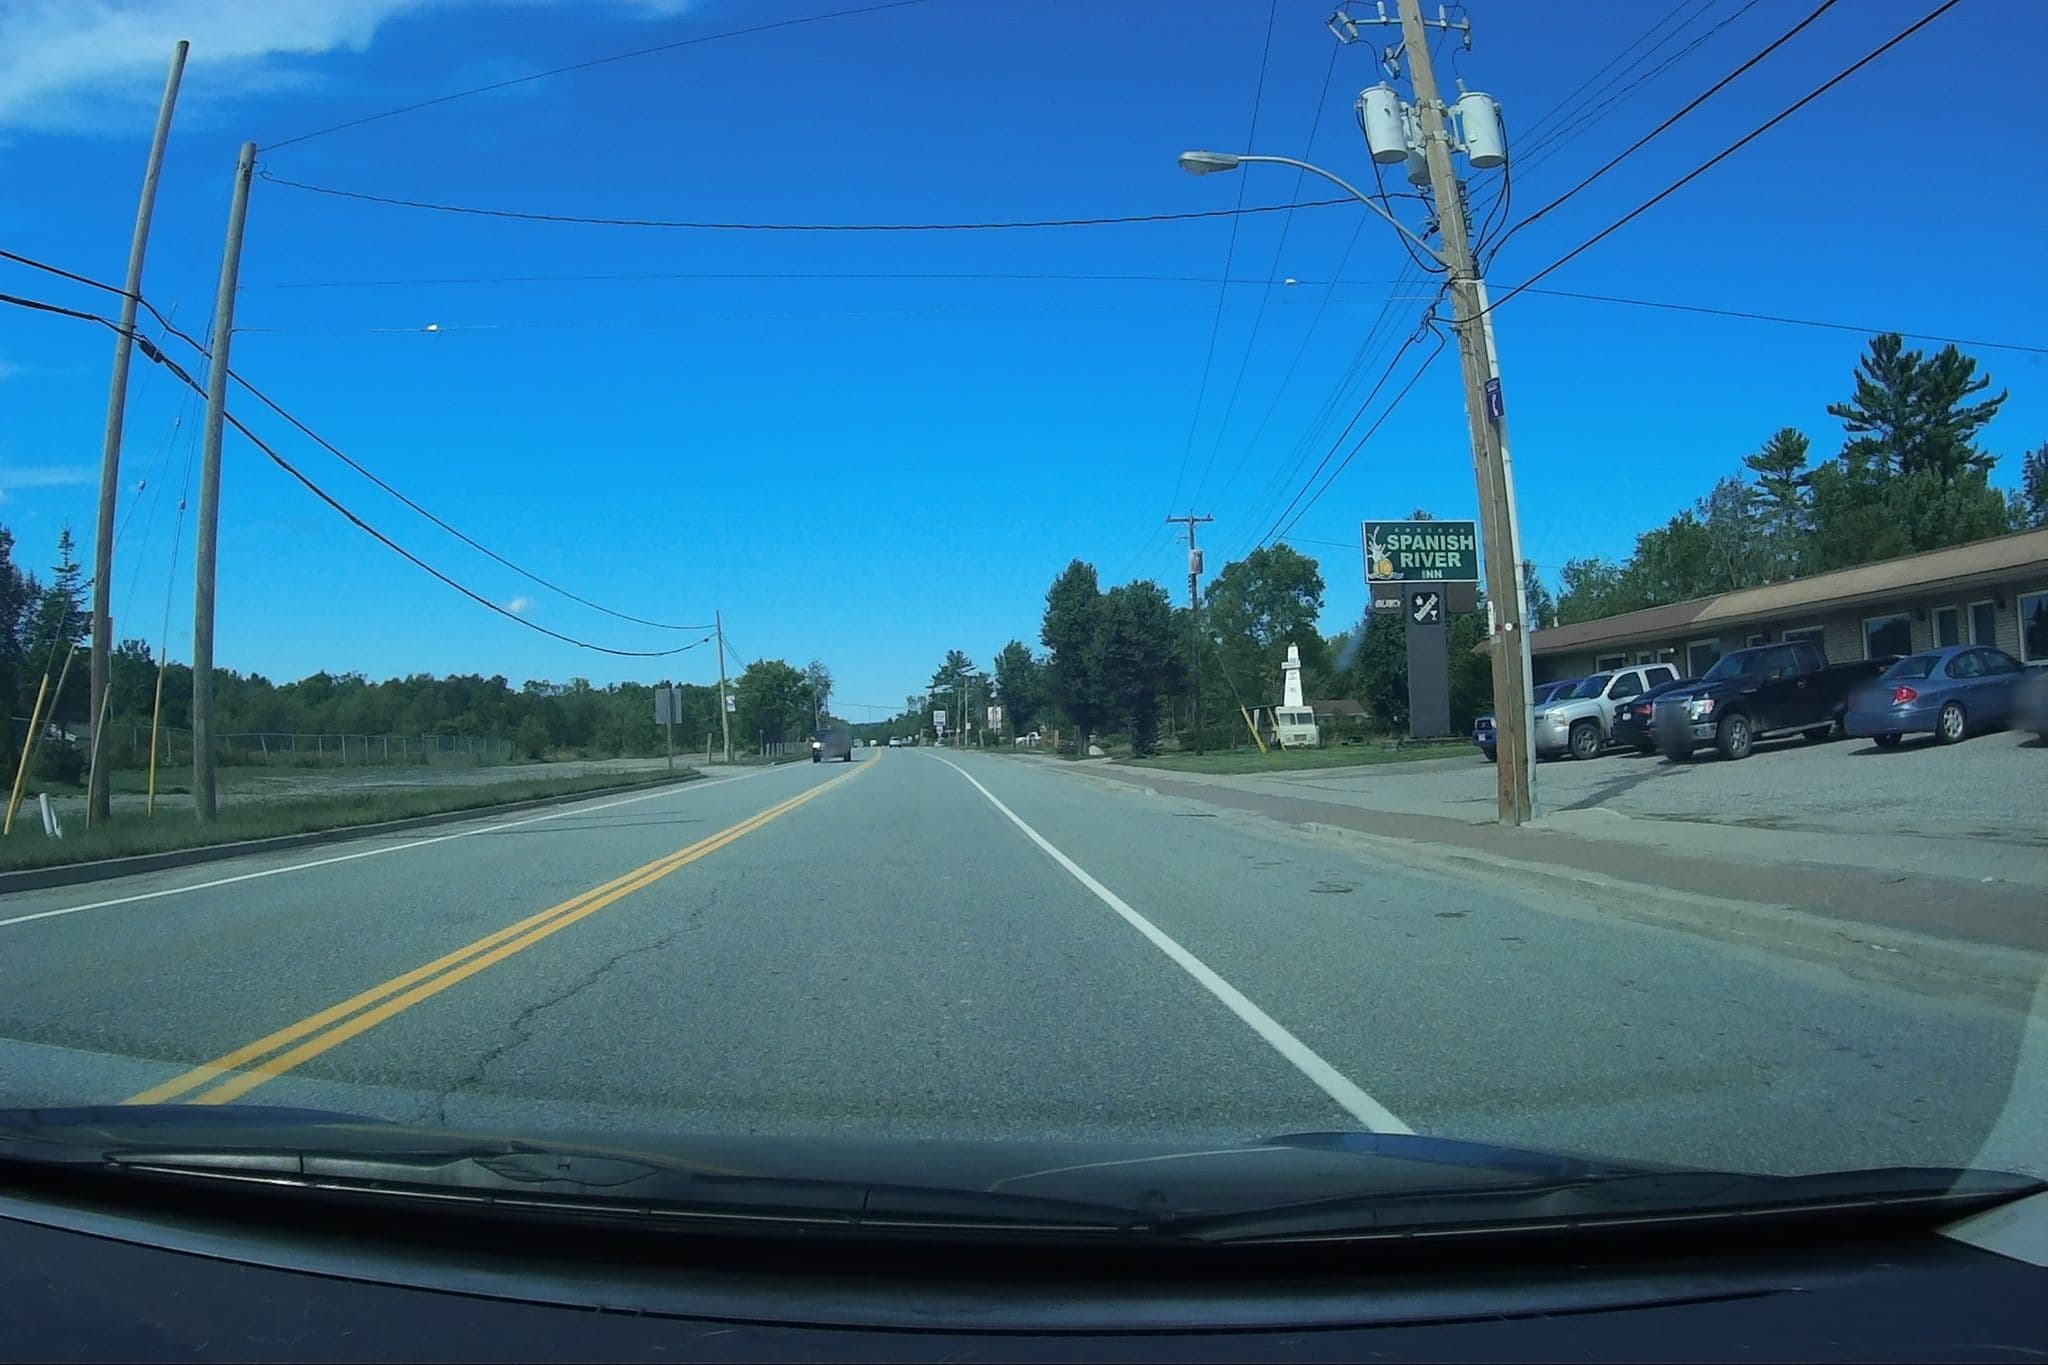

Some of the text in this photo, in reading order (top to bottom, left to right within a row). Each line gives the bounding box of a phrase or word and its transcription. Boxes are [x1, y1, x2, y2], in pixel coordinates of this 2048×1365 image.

[1386, 535, 1474, 551] SPANISH
[1399, 552, 1462, 568] RIVER
[1421, 569, 1443, 579] INN
